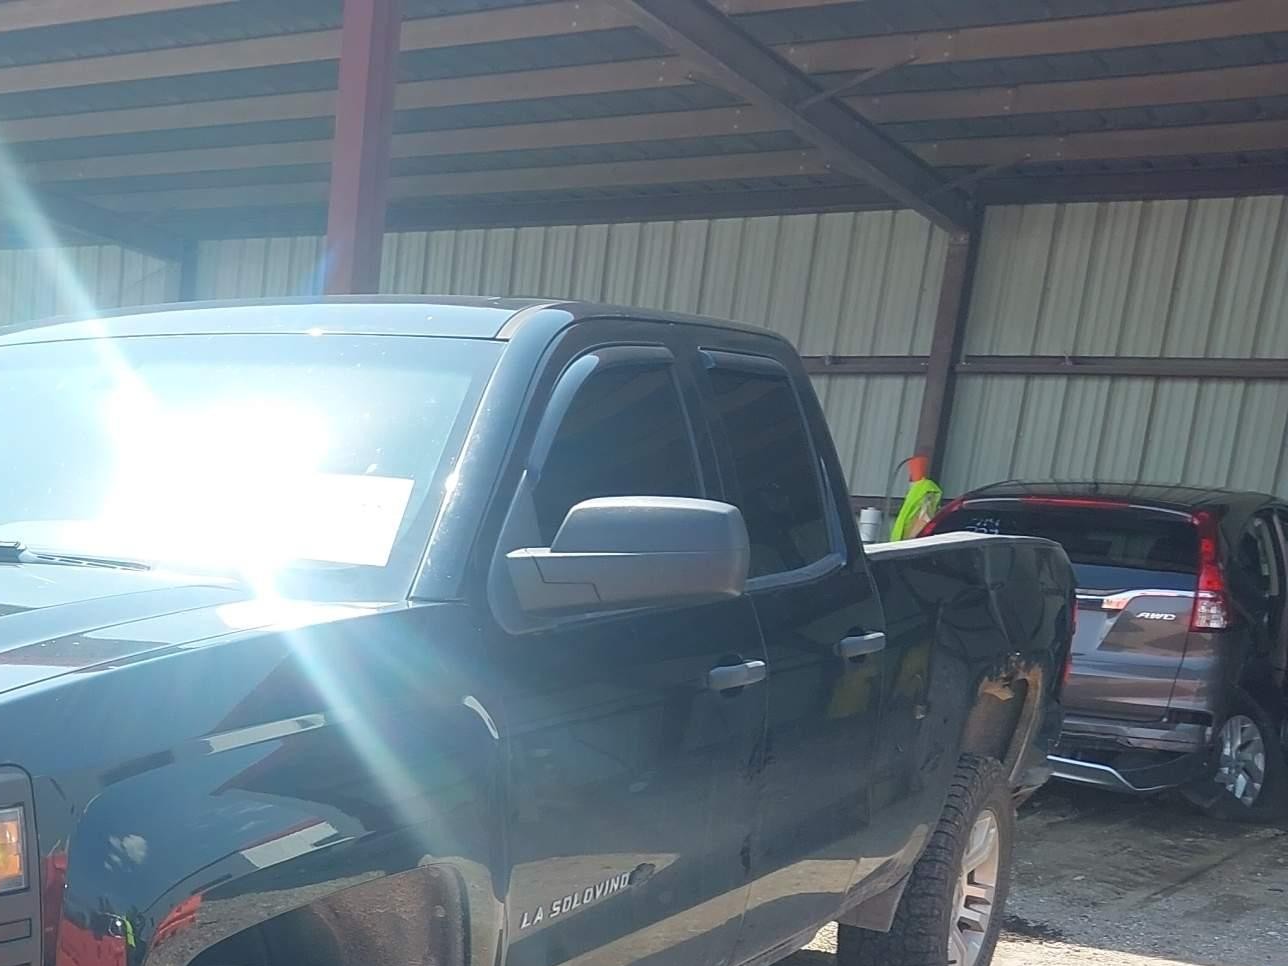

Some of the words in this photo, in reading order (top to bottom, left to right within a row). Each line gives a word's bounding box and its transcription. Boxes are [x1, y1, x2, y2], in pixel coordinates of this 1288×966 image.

[1135, 611, 1177, 621] AWD
[520, 906, 545, 930] LA
[549, 871, 631, 918] SOLOVINO
